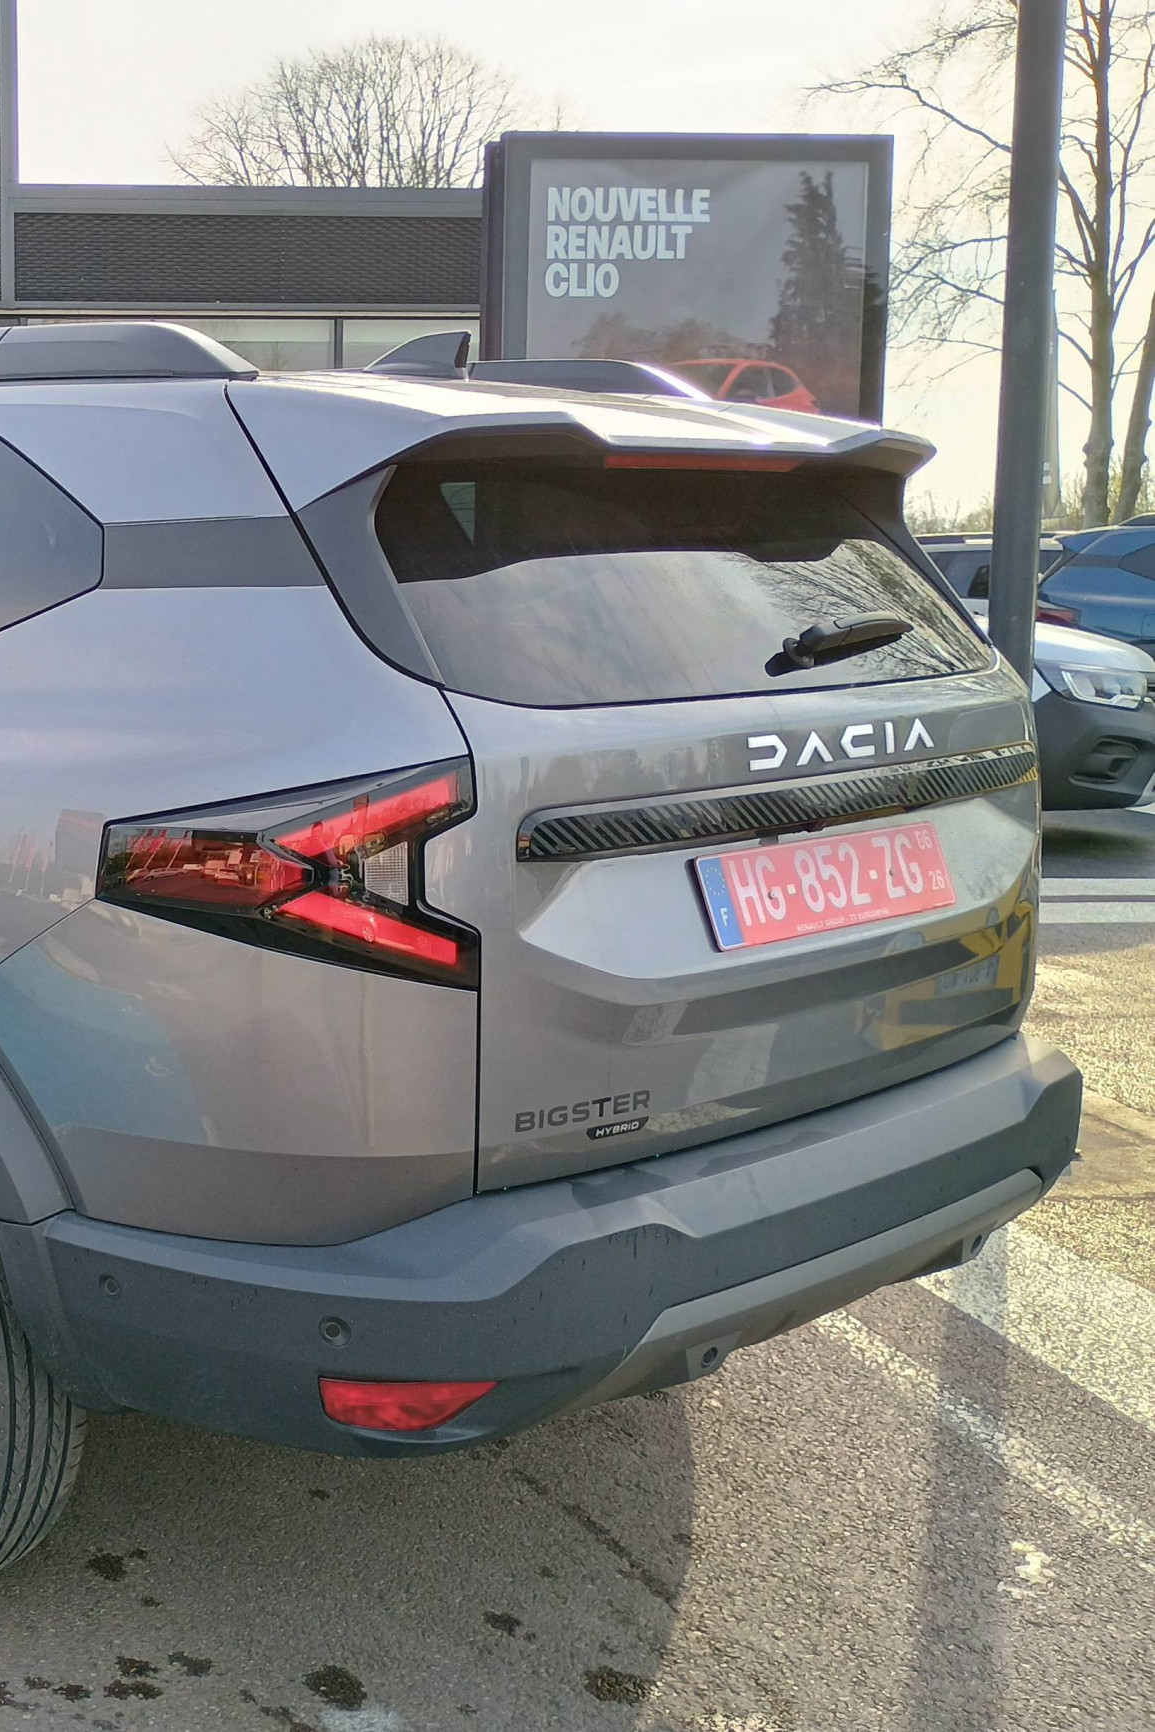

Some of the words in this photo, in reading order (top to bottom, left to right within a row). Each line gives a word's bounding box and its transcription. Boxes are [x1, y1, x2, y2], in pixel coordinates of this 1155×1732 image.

[547, 187, 711, 223] NOUVELLE
[546, 225, 693, 260] RENAULT
[545, 262, 620, 298] CLIO
[747, 717, 935, 772] DACIA
[728, 834, 924, 927] HG-852-ZG
[928, 870, 945, 891] 26
[719, 907, 729, 927] F
[515, 1089, 651, 1132] BIGSTER
[596, 1120, 640, 1138] HYBRID
